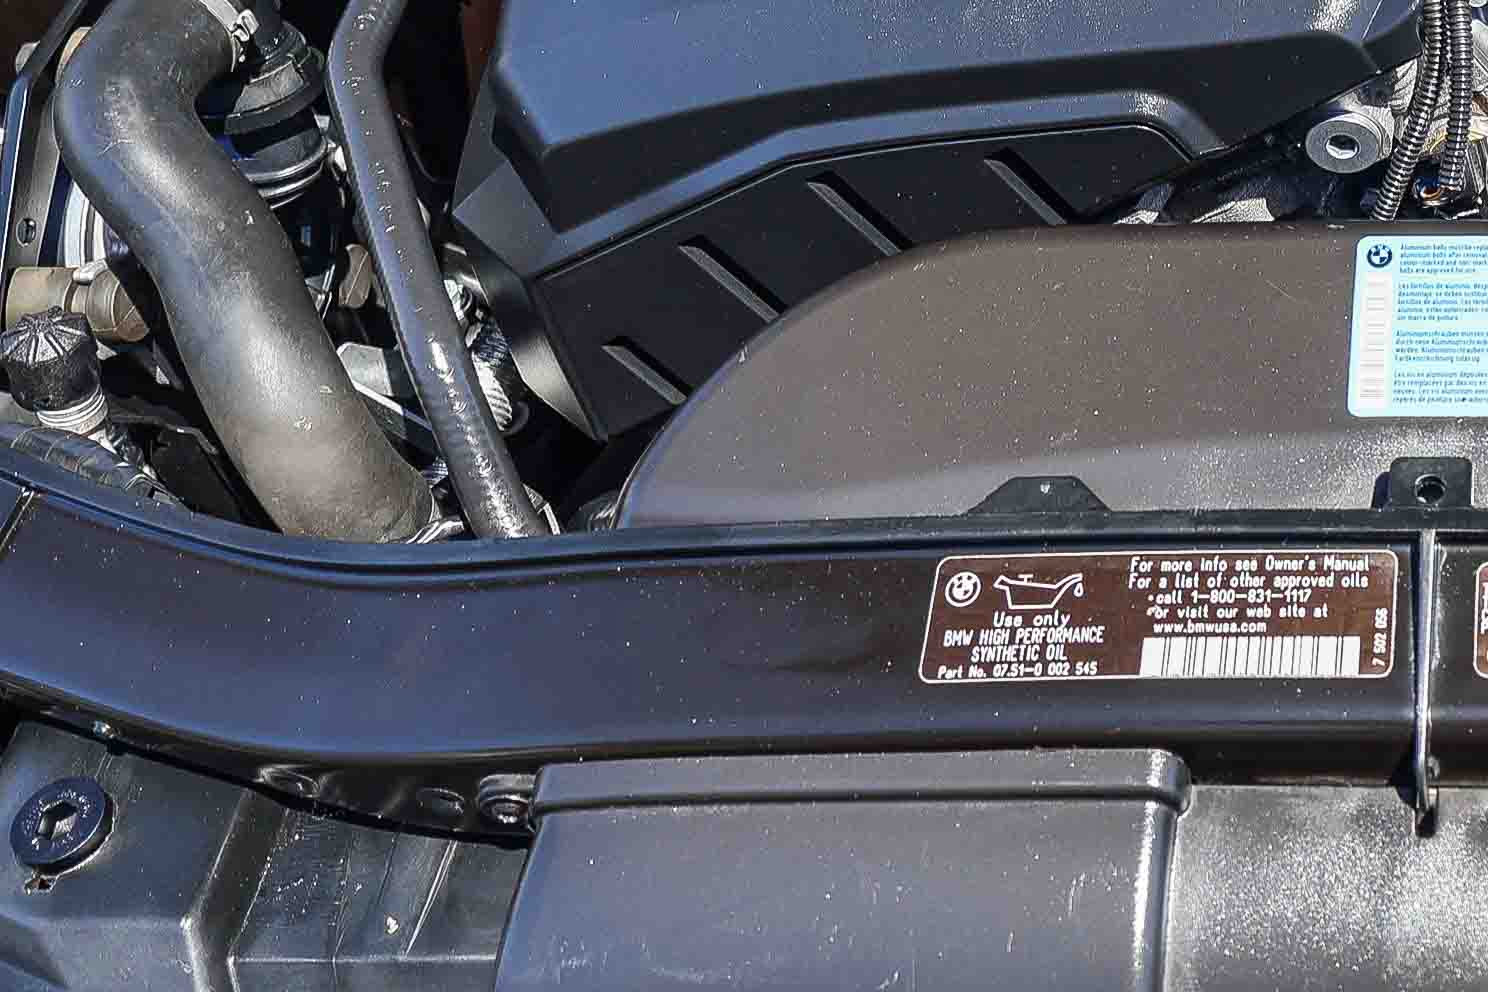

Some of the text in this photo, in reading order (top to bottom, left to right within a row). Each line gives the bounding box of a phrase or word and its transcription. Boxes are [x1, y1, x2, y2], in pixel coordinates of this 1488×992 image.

[1130, 556, 1153, 572] For
[1160, 560, 1192, 572] more
[1235, 559, 1258, 571] see
[1265, 555, 1316, 571] Owner's
[1324, 555, 1369, 571] Manual
[1128, 572, 1368, 591] For a list of other approved oils
[1156, 588, 1312, 604] call 1-800-831-1117
[1177, 604, 1209, 618] visit
[1216, 608, 1238, 618] our
[1246, 603, 1272, 618] web
[1279, 605, 1306, 617] site
[1313, 603, 1328, 617] at
[993, 610, 1071, 630] Use only
[1153, 619, 1266, 633] www.bmwusa.com
[943, 626, 1105, 647] BMW HIGH PERFORMANCE
[971, 644, 1068, 663] SYNTHETIC OIL
[1372, 657, 1385, 667] 7
[937, 665, 963, 679] Part
[968, 666, 987, 678] No.
[1048, 662, 1069, 676] 002
